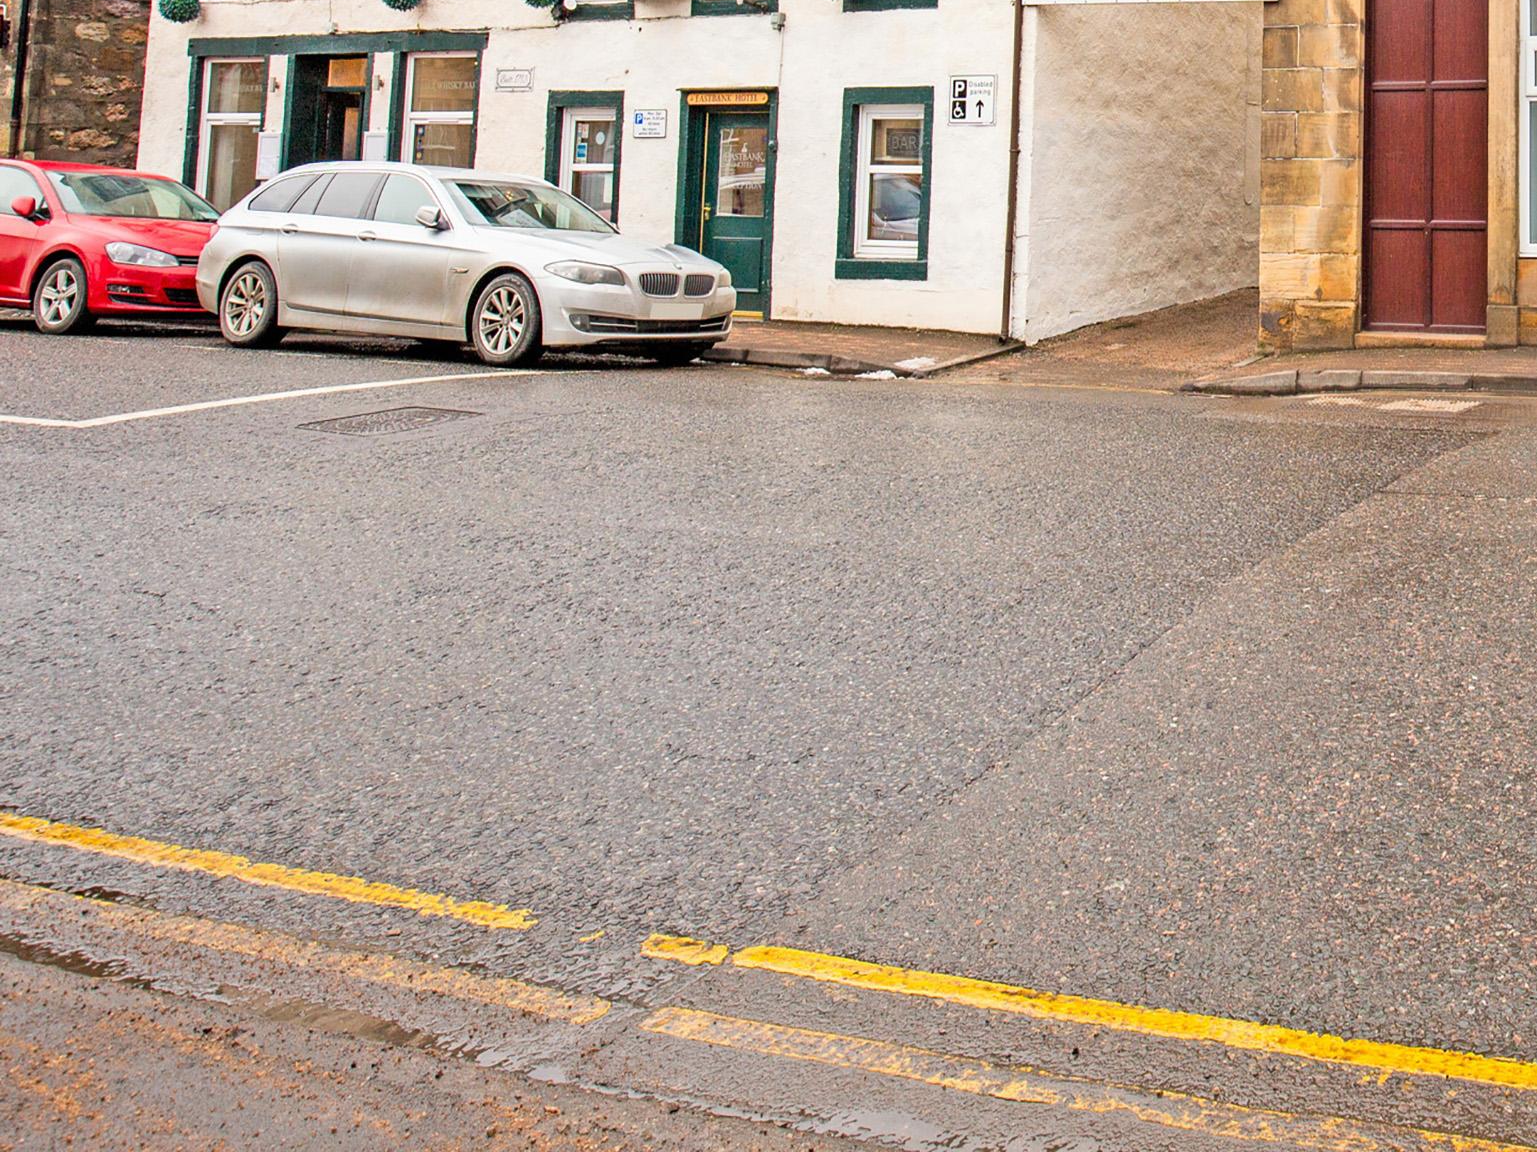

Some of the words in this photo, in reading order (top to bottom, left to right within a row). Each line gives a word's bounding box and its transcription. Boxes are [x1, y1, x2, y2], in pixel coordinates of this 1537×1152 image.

[968, 80, 993, 88] Disabled
[969, 88, 992, 97] parking
[695, 95, 732, 103] EASTBANK
[735, 94, 757, 102] HOTEL
[891, 135, 917, 150] BAR
